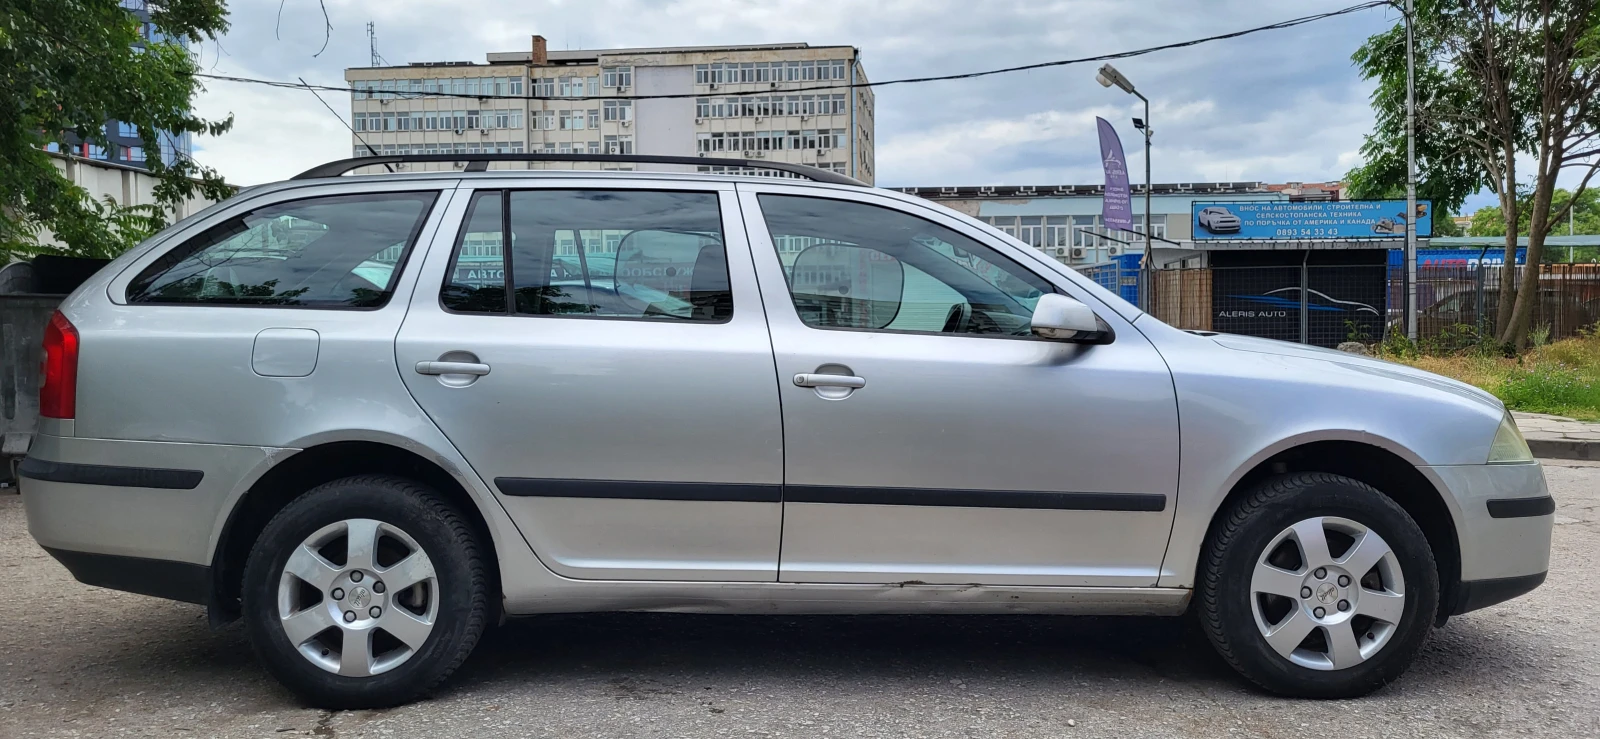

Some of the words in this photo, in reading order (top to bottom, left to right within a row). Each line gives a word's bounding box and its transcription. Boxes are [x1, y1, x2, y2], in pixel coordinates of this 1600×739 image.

[1256, 211, 1328, 219] СЕЛСКОСТОПАНСКА
[1276, 228, 1298, 236] 0893
[1300, 228, 1311, 236] 54
[1314, 228, 1325, 236] 33
[1218, 310, 1256, 318] ALERIS
[1258, 310, 1287, 318] AUTO
